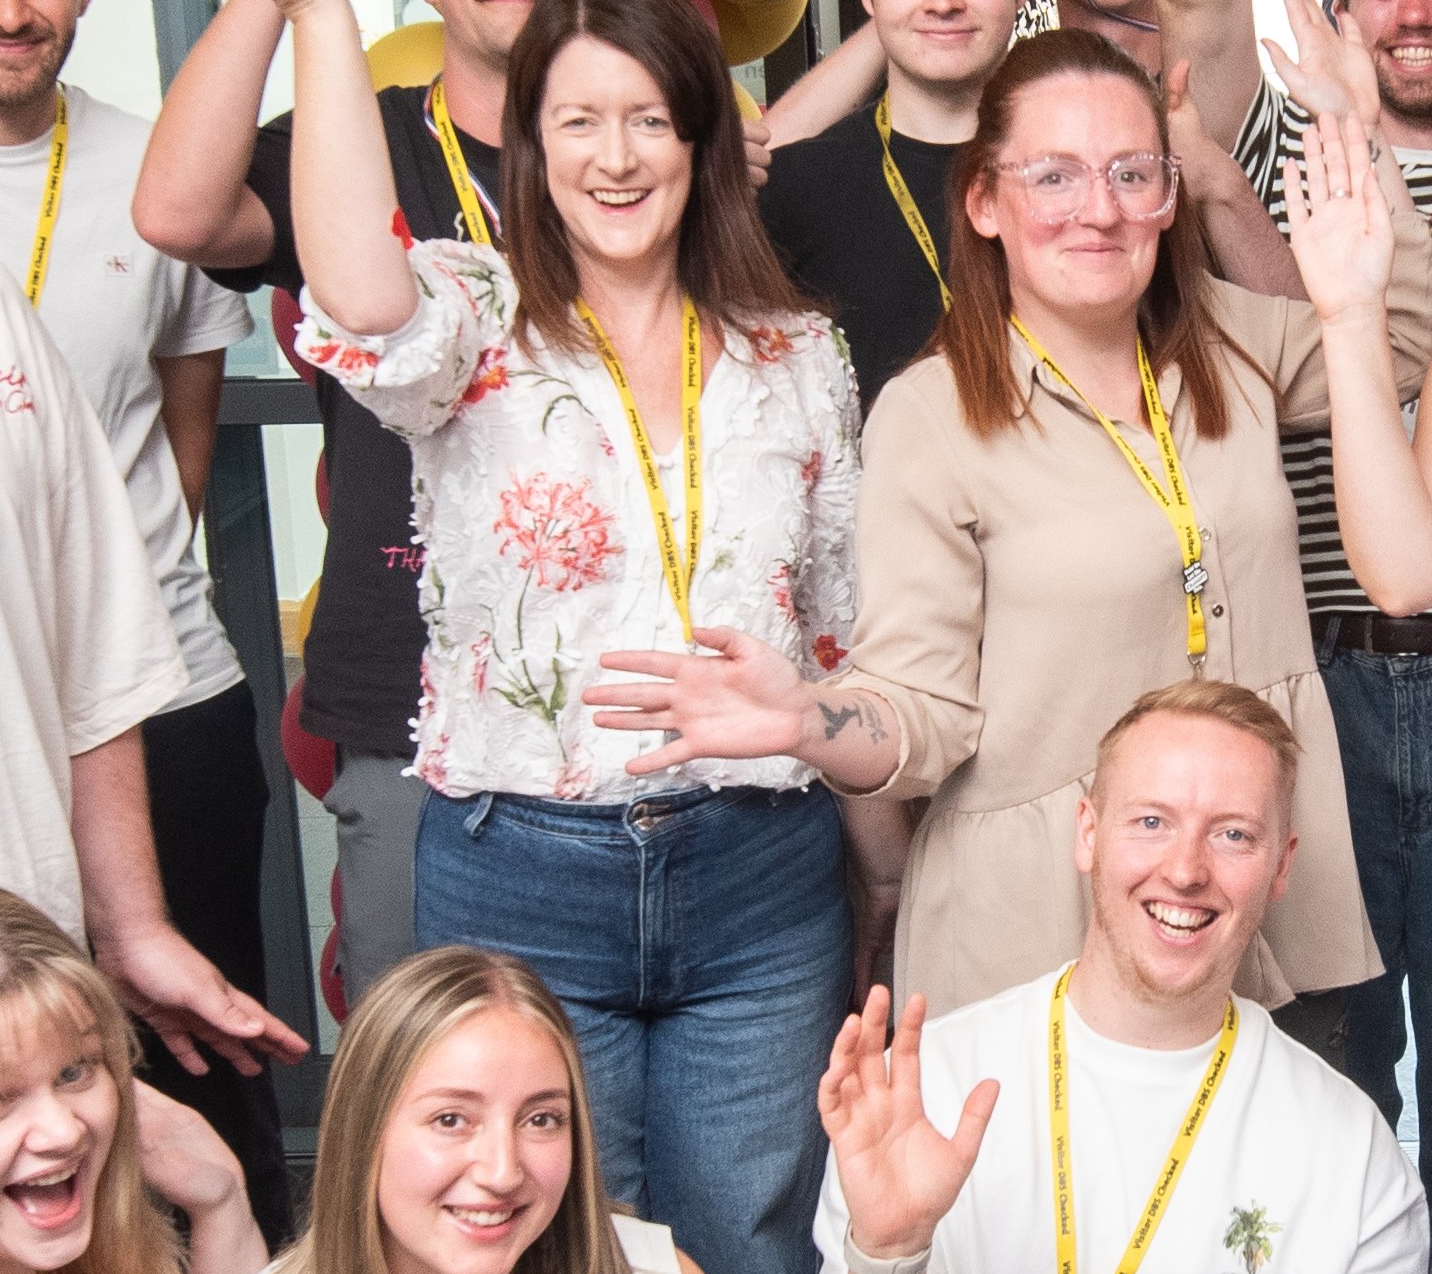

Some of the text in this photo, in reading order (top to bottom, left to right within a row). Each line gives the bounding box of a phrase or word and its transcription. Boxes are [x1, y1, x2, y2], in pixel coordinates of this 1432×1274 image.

[627, 407, 659, 491] Visitor DBS Checked
[1159, 431, 1187, 506] Visitor DBS Checked
[1183, 1049, 1227, 1137] Visitor DBS Checked
[1132, 1157, 1180, 1249] Visitor DBS Checked
